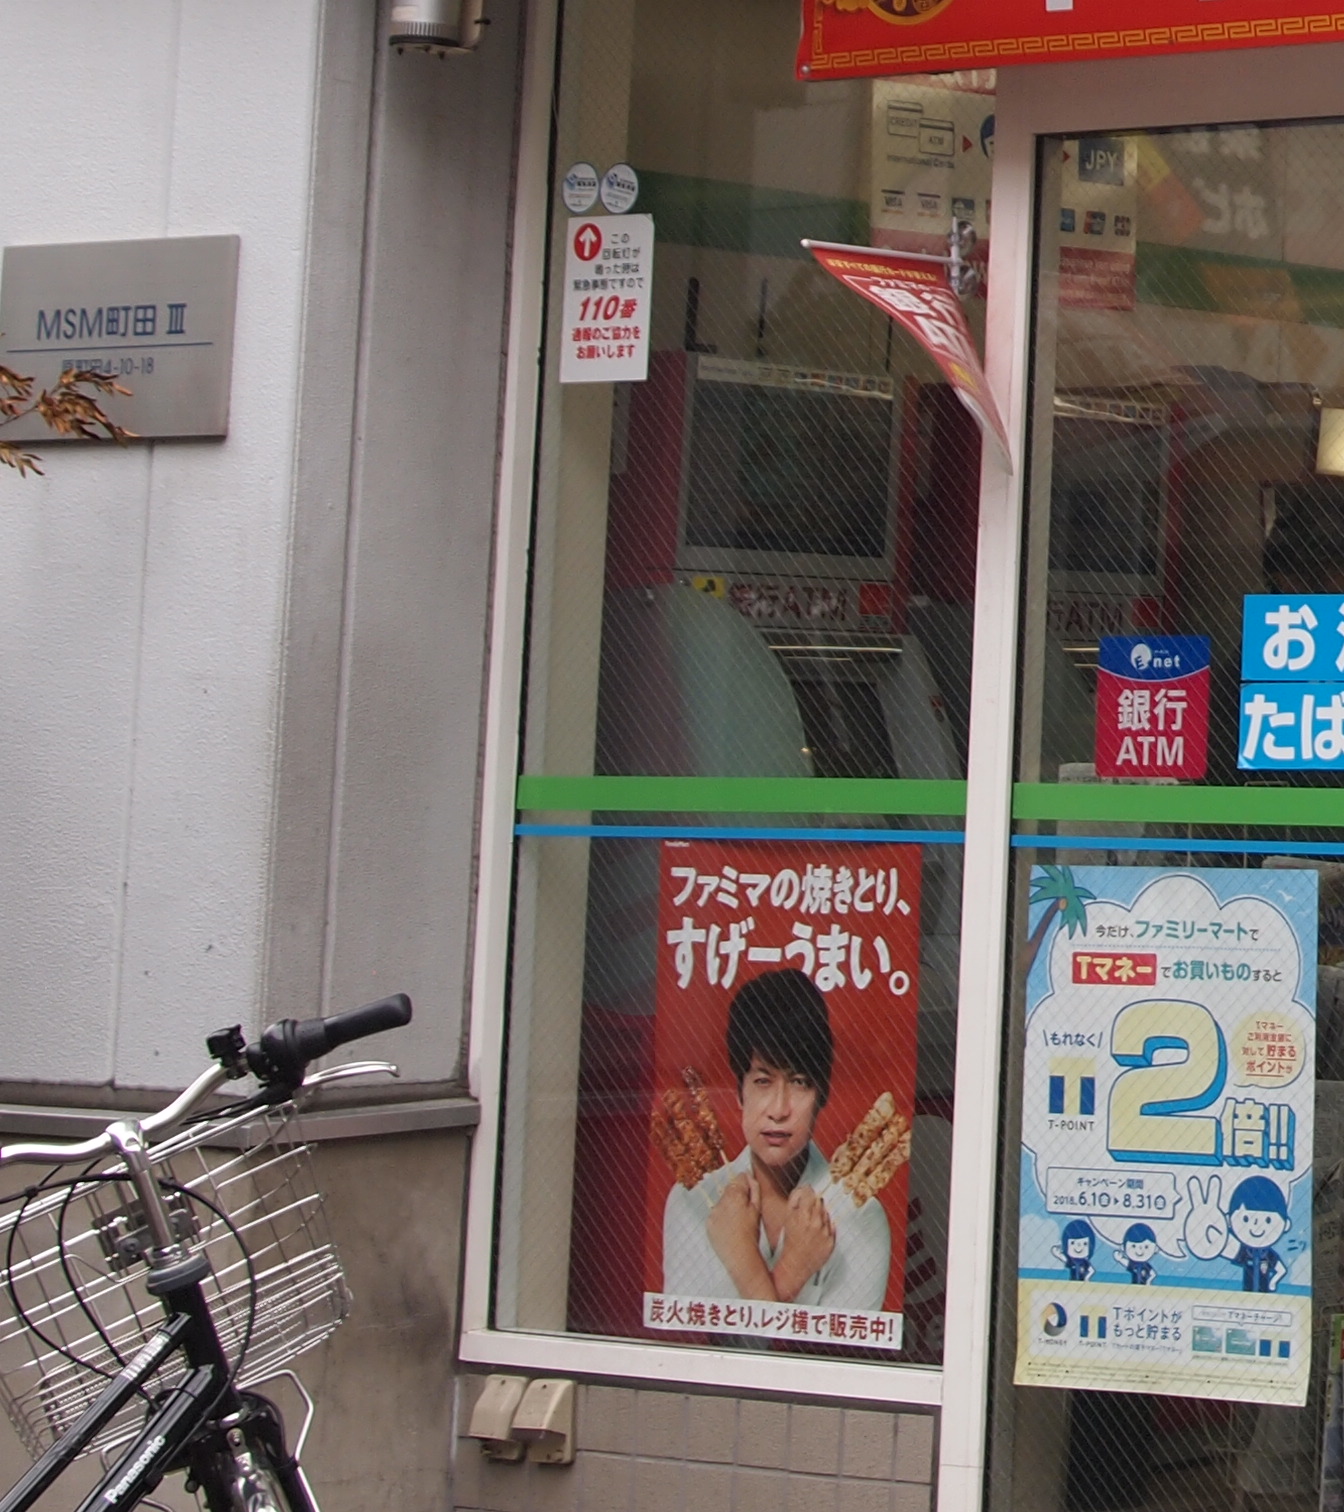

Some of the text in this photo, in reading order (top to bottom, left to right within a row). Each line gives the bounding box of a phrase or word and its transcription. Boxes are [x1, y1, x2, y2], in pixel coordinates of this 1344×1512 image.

[1085, 147, 1118, 173] JPY
[610, 233, 630, 245] この
[602, 247, 641, 260] 回転灯が
[578, 294, 637, 321] 110番
[36, 304, 157, 341] MSM町田
[572, 325, 640, 342] 通報のご協力を
[576, 344, 635, 360] お願いします
[1116, 688, 1188, 732] 銀行
[1116, 736, 1184, 766] ATM
[670, 863, 911, 916] ファミマの焼きとり、
[1095, 919, 1259, 941] 今だけ、ファミリーマートで
[666, 915, 910, 996] すげーうまい。
[1049, 1031, 1095, 1048] もれなく
[1048, 1119, 1095, 1131] T-POINT
[1113, 1306, 1183, 1324] Tポイントが
[1113, 1324, 1183, 1342] もっと貯まる
